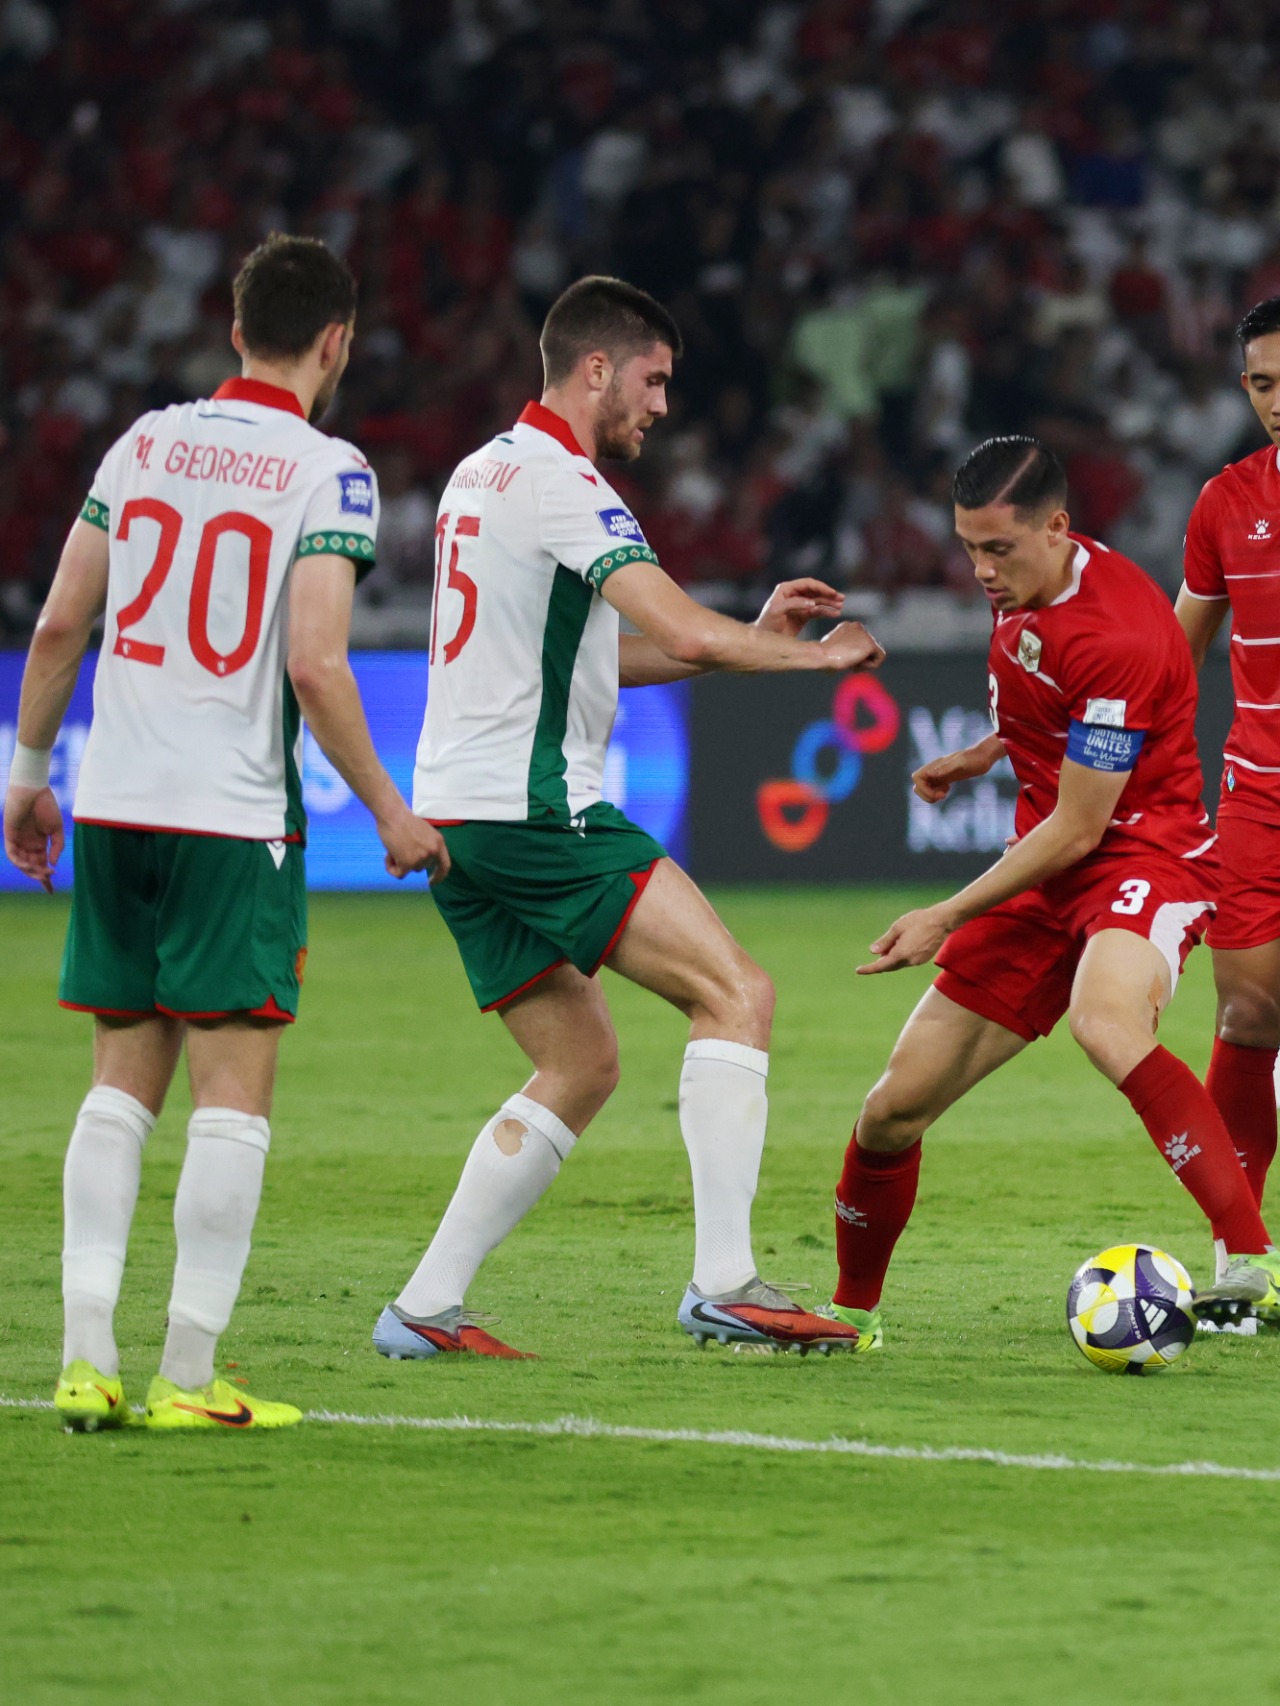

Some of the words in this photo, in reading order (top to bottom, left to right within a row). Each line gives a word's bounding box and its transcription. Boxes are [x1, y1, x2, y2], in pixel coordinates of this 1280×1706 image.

[164, 440, 298, 492] GEORGIEV
[113, 497, 273, 678] 20
[430, 513, 480, 667] 15
[1086, 734, 1132, 754] UNITES
[1091, 728, 1132, 742] FOOTBALL
[1111, 879, 1151, 915] 3
